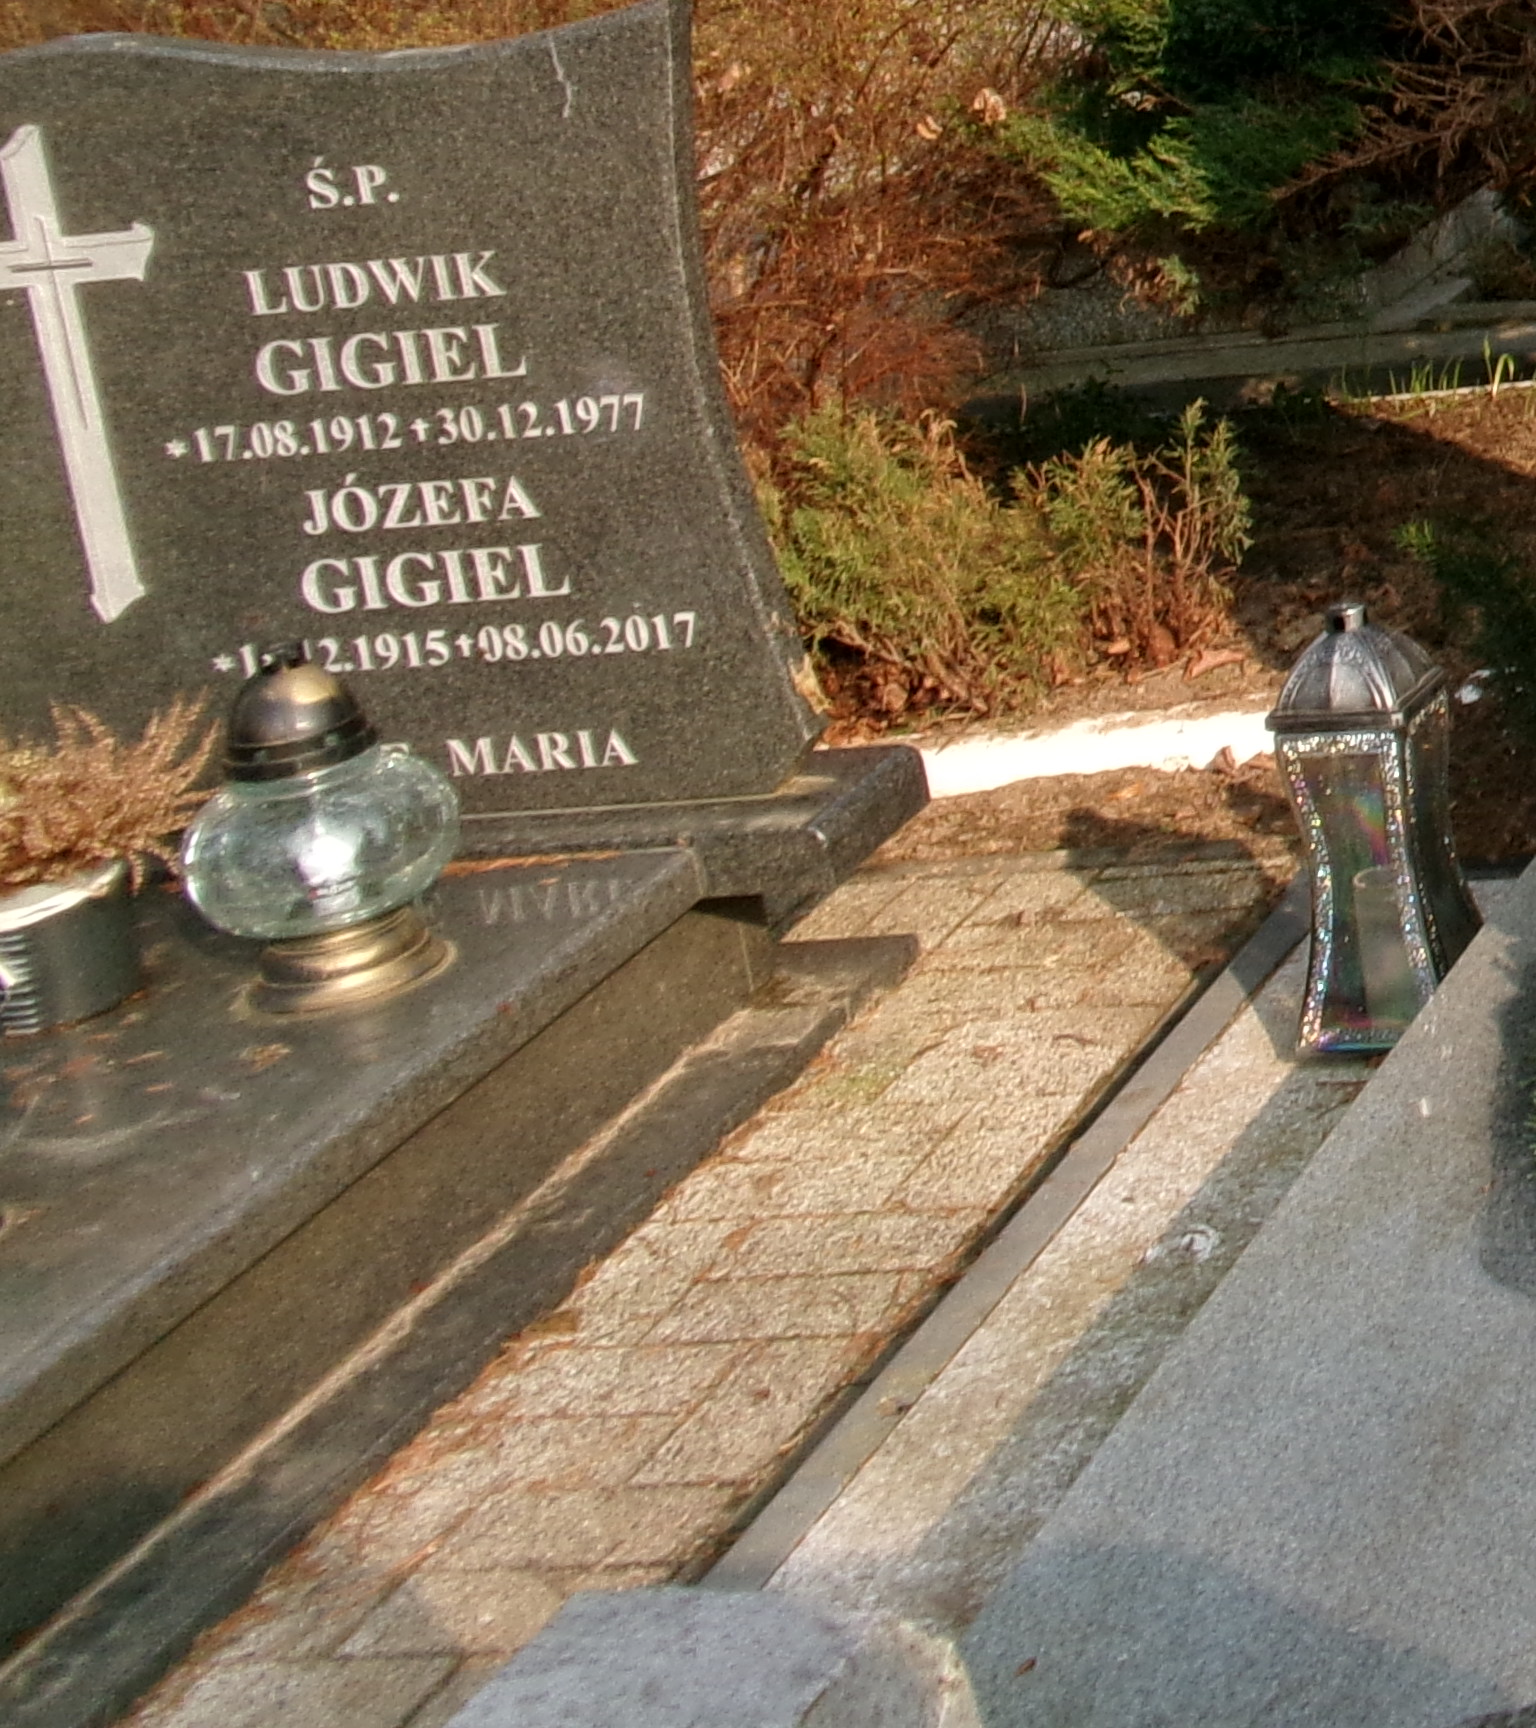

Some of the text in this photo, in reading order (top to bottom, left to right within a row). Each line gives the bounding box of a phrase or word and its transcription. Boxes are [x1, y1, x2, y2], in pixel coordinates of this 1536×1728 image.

[243, 250, 507, 316] LUDWIK
[254, 323, 528, 396] GIGIEL
[303, 472, 541, 536] JÓZEFA
[299, 543, 571, 616] GIGIEL
[447, 728, 638, 778] MARIA
